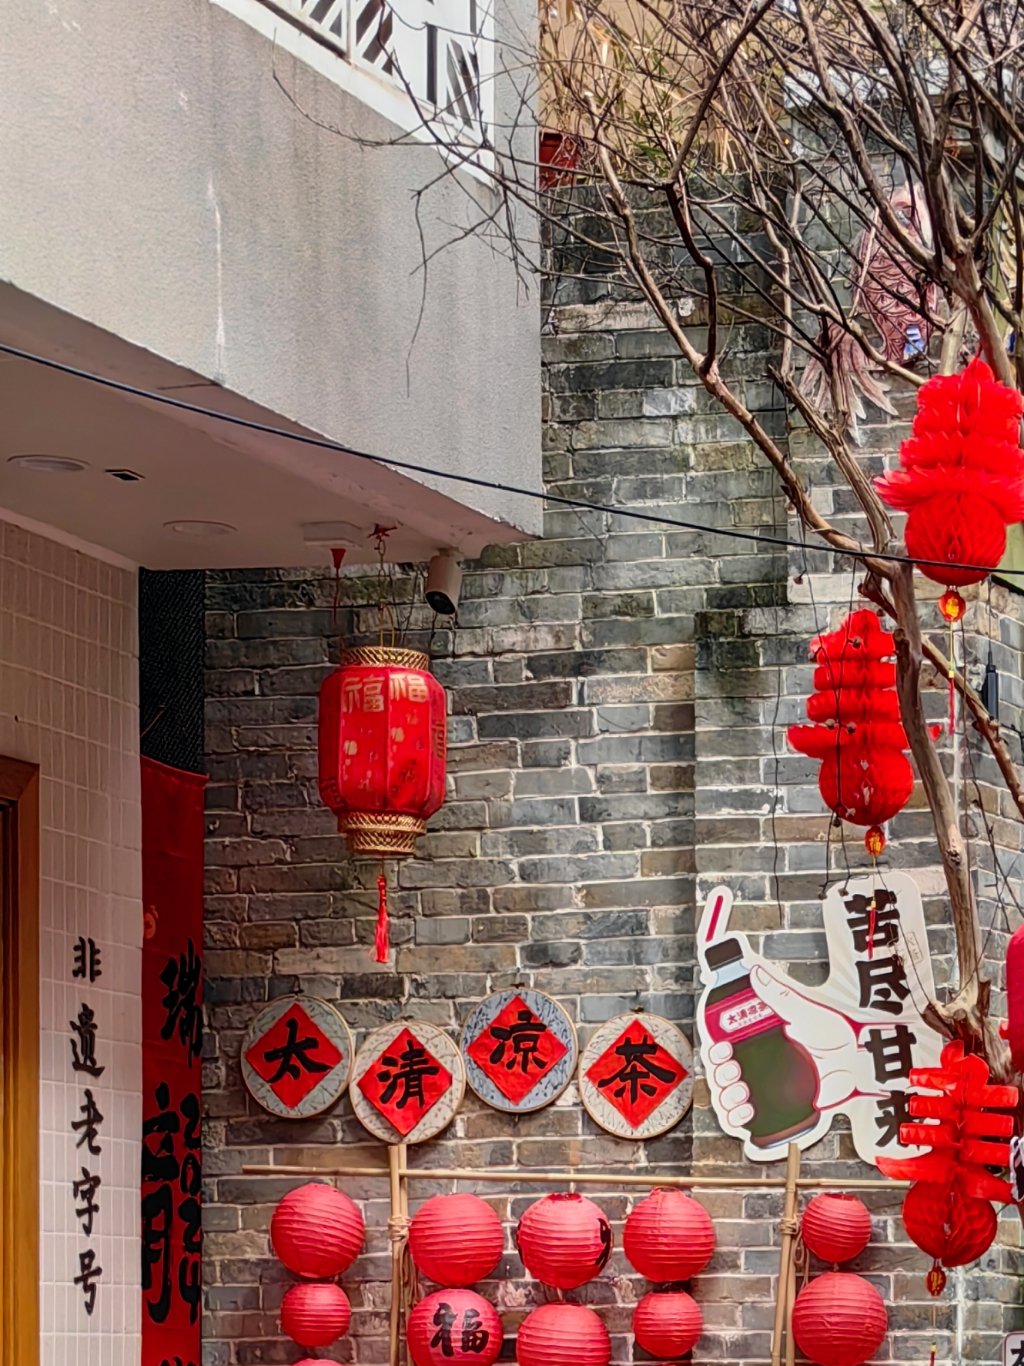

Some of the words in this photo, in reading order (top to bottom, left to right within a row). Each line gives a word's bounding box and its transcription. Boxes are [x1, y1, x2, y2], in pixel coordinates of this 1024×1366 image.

[263, 1009, 678, 1111] 太清凉茶
[70, 936, 105, 1316] 非遗老字号
[430, 1303, 489, 1357] 福
